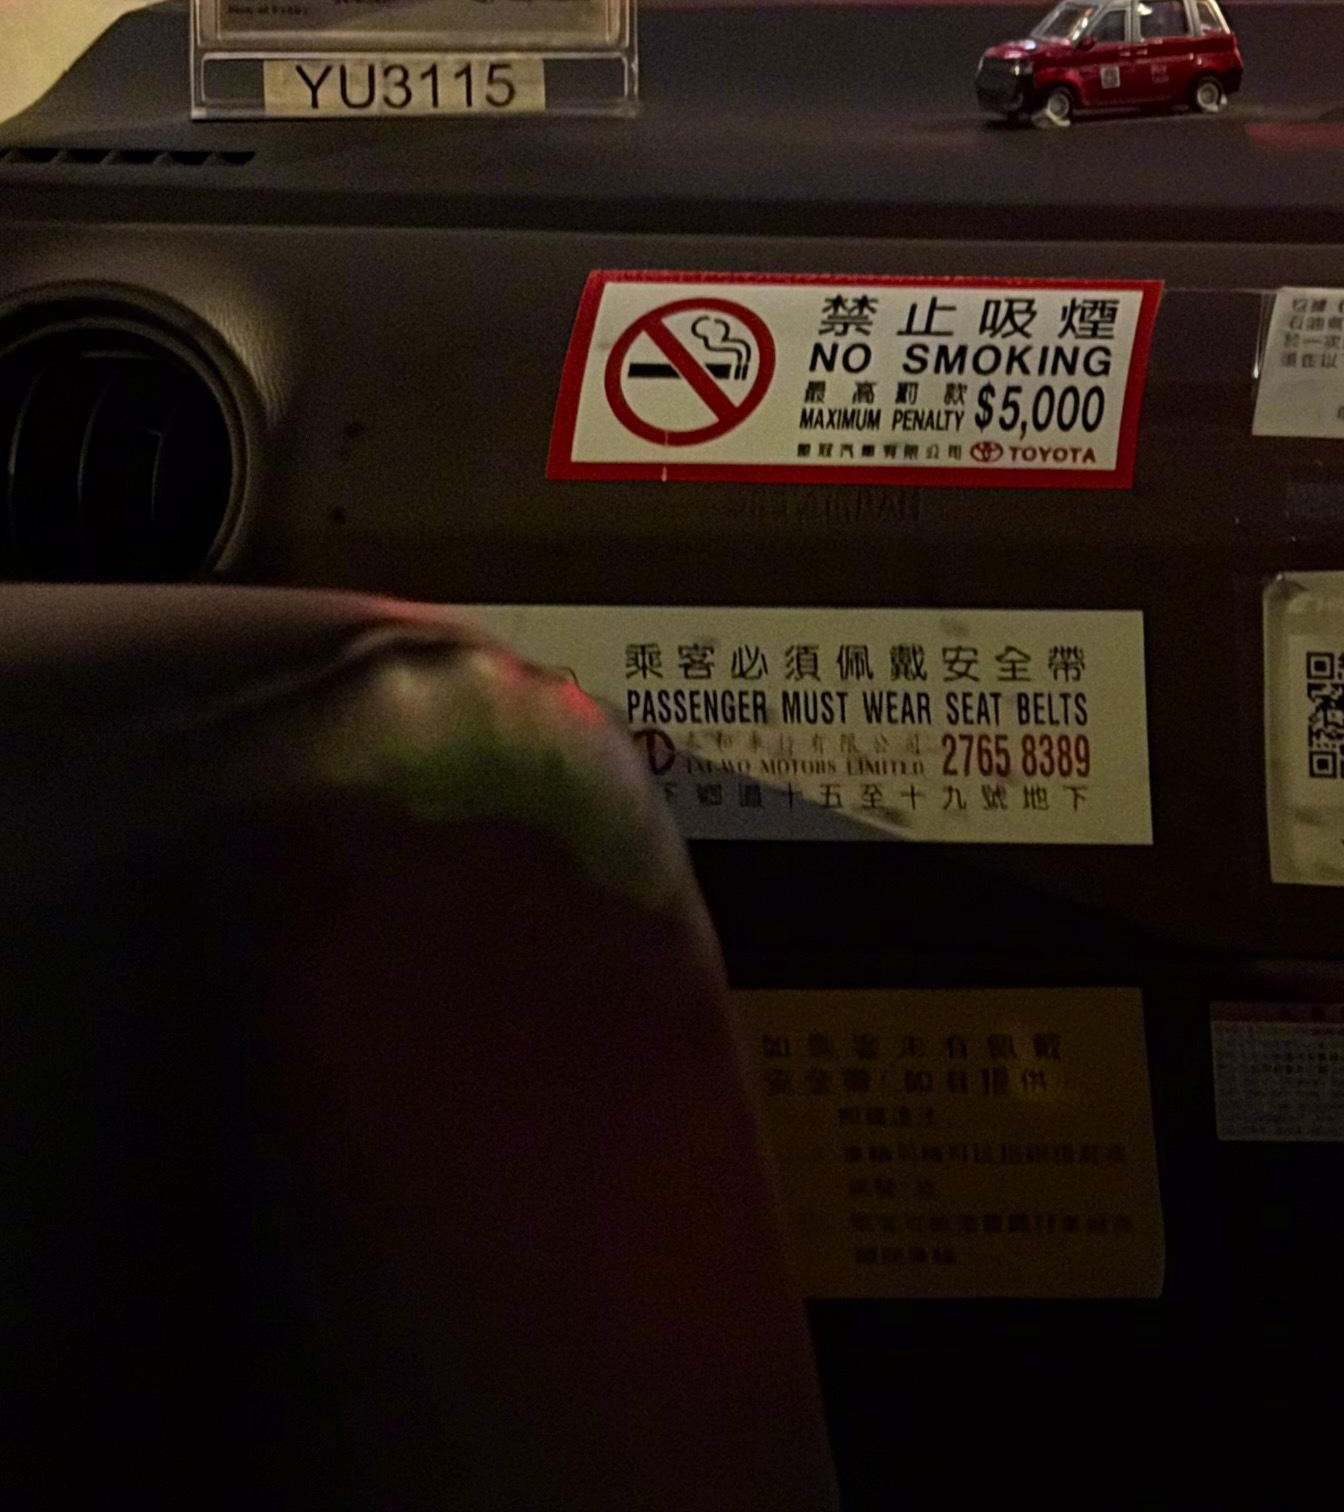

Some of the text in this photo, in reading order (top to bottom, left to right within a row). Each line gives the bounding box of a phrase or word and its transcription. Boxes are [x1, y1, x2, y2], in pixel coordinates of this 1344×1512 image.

[295, 62, 518, 110] YU3115
[818, 294, 1120, 341] 禁止吸煙
[808, 343, 1114, 377] NO SMOKING
[800, 408, 965, 432] MAXIMUM PENALTY
[974, 381, 1105, 440] $5,000
[1008, 447, 1097, 464] TOYOTA
[624, 643, 1087, 683] 乘客必須佩戴安全帶
[628, 690, 1089, 727] PASSENGER MUST WEAR SEAT BELTS
[761, 759, 837, 775] MOTORS
[846, 760, 925, 776] LIMITED
[941, 733, 1092, 778] 2765 8389
